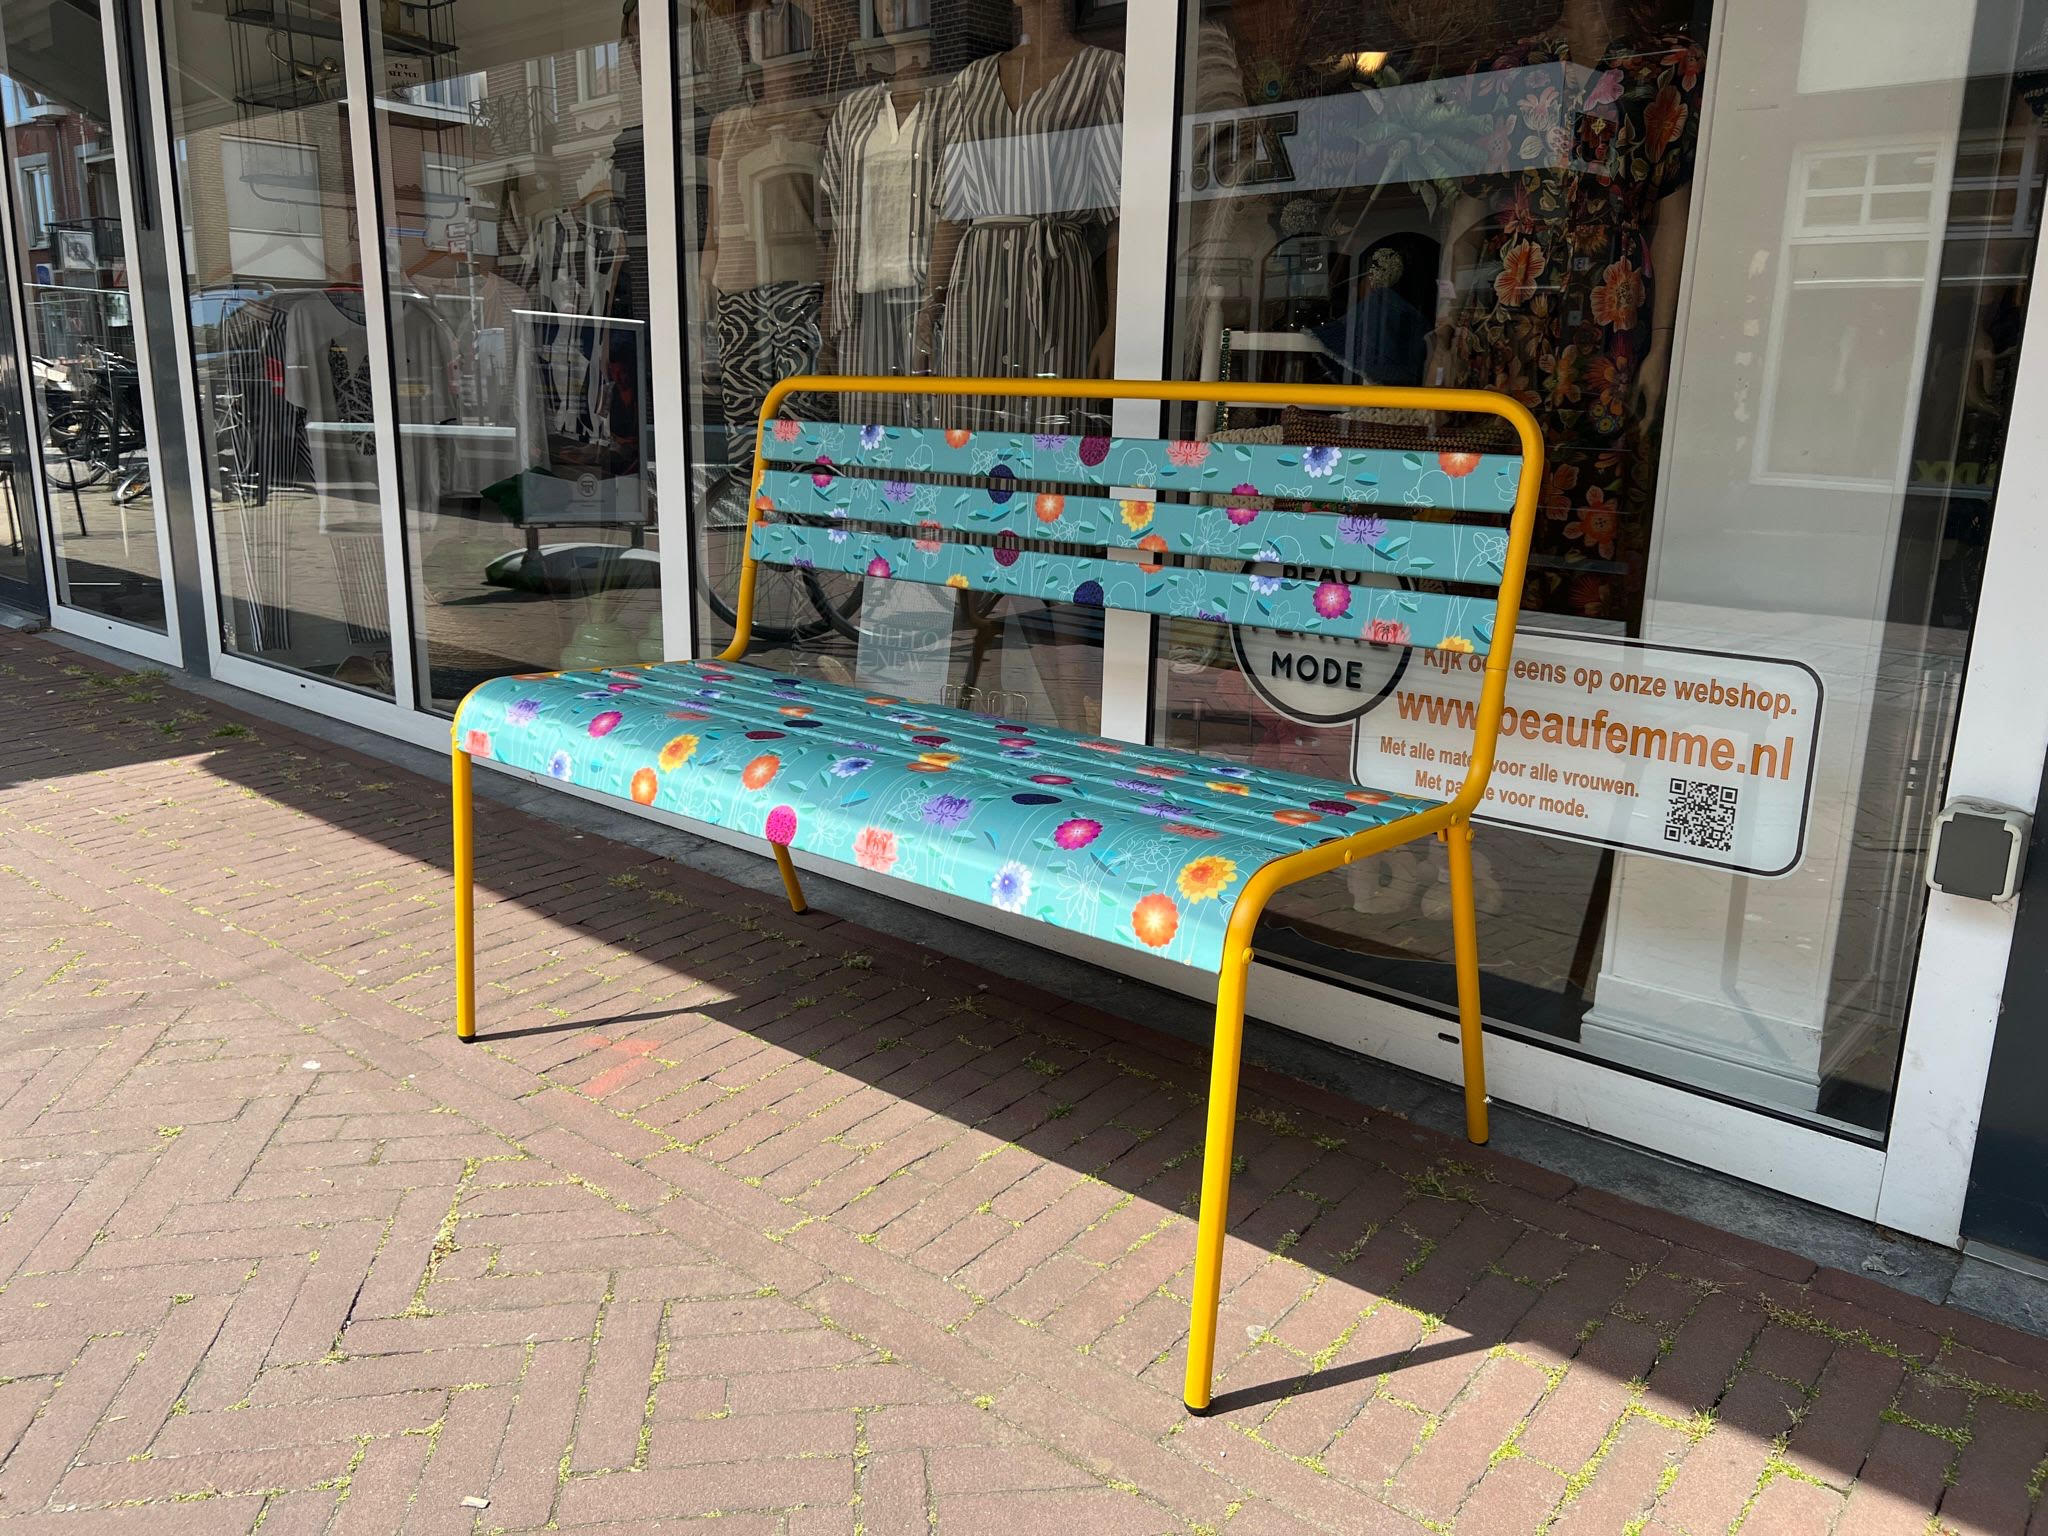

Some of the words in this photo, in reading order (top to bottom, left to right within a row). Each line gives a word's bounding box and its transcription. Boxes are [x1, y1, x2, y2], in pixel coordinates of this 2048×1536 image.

[869, 626, 939, 652] HELLO
[876, 649, 929, 673] NEW
[1271, 650, 1363, 689] MODE
[1423, 648, 1463, 675] Kijk
[1513, 659, 1567, 684] eens
[1573, 667, 1602, 694] op
[1609, 672, 1667, 697] onze
[1674, 678, 1798, 720] webshop.
[1396, 690, 1795, 781] wwwbeaufemme.nl
[1380, 735, 1406, 758] Met
[1409, 741, 1435, 761] alle
[1530, 762, 1558, 783] alle
[1563, 769, 1640, 798] vrouwen.
[1415, 769, 1442, 791] Met
[1499, 785, 1536, 808] voor
[1539, 791, 1589, 819] mode.
